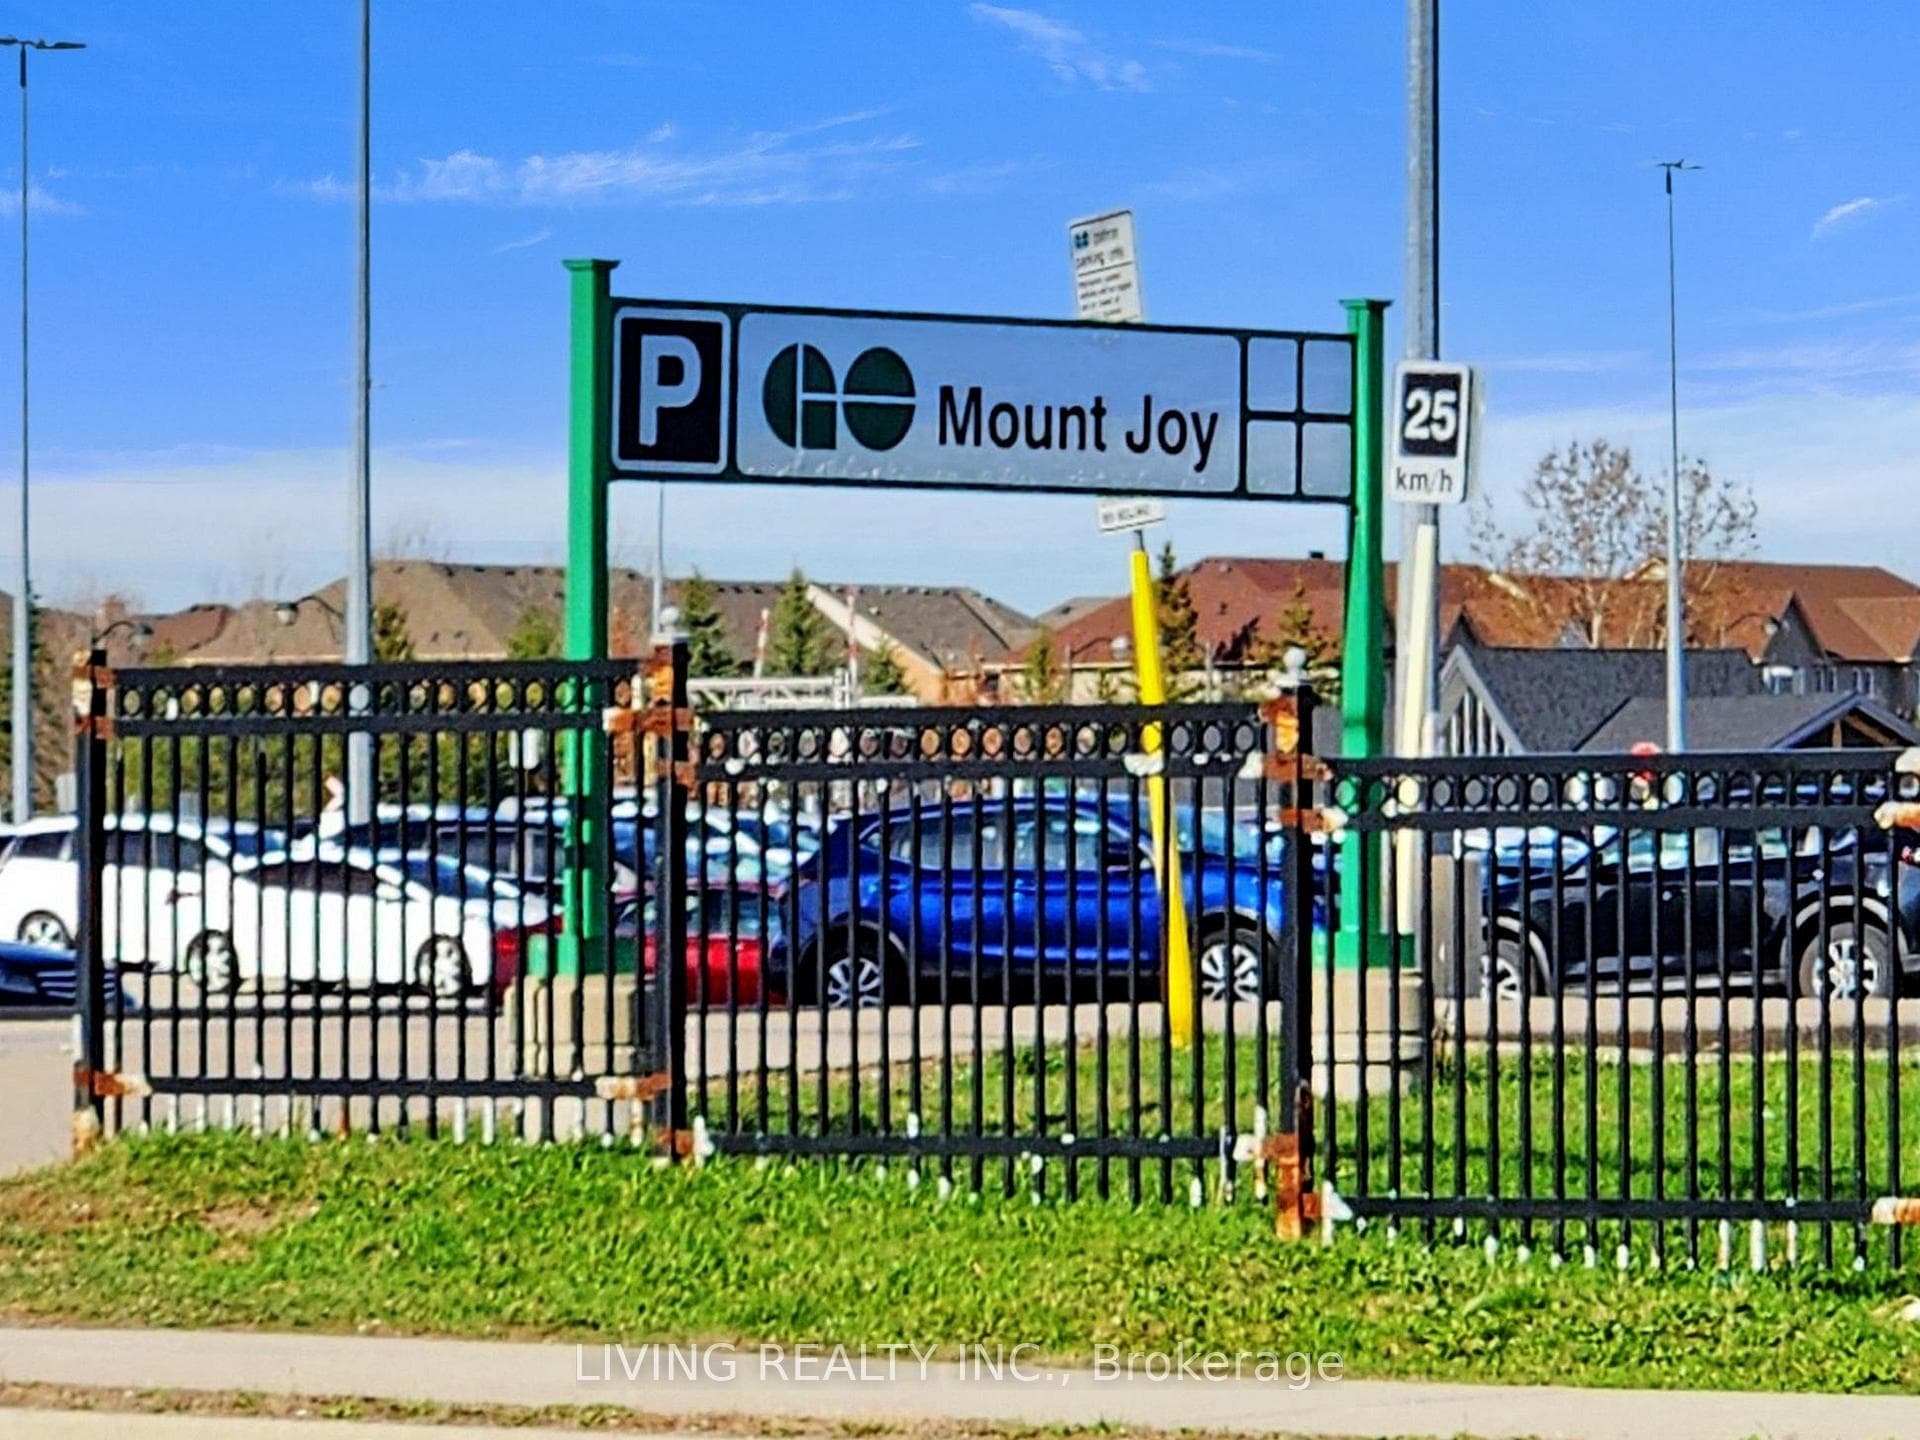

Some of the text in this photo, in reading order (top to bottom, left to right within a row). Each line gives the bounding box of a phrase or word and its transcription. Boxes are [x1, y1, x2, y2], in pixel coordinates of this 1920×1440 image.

[638, 334, 702, 446] P
[1404, 389, 1457, 442] 25
[938, 385, 1107, 453] Mount
[1126, 395, 1219, 472] Joy
[1396, 467, 1453, 494] km/h
